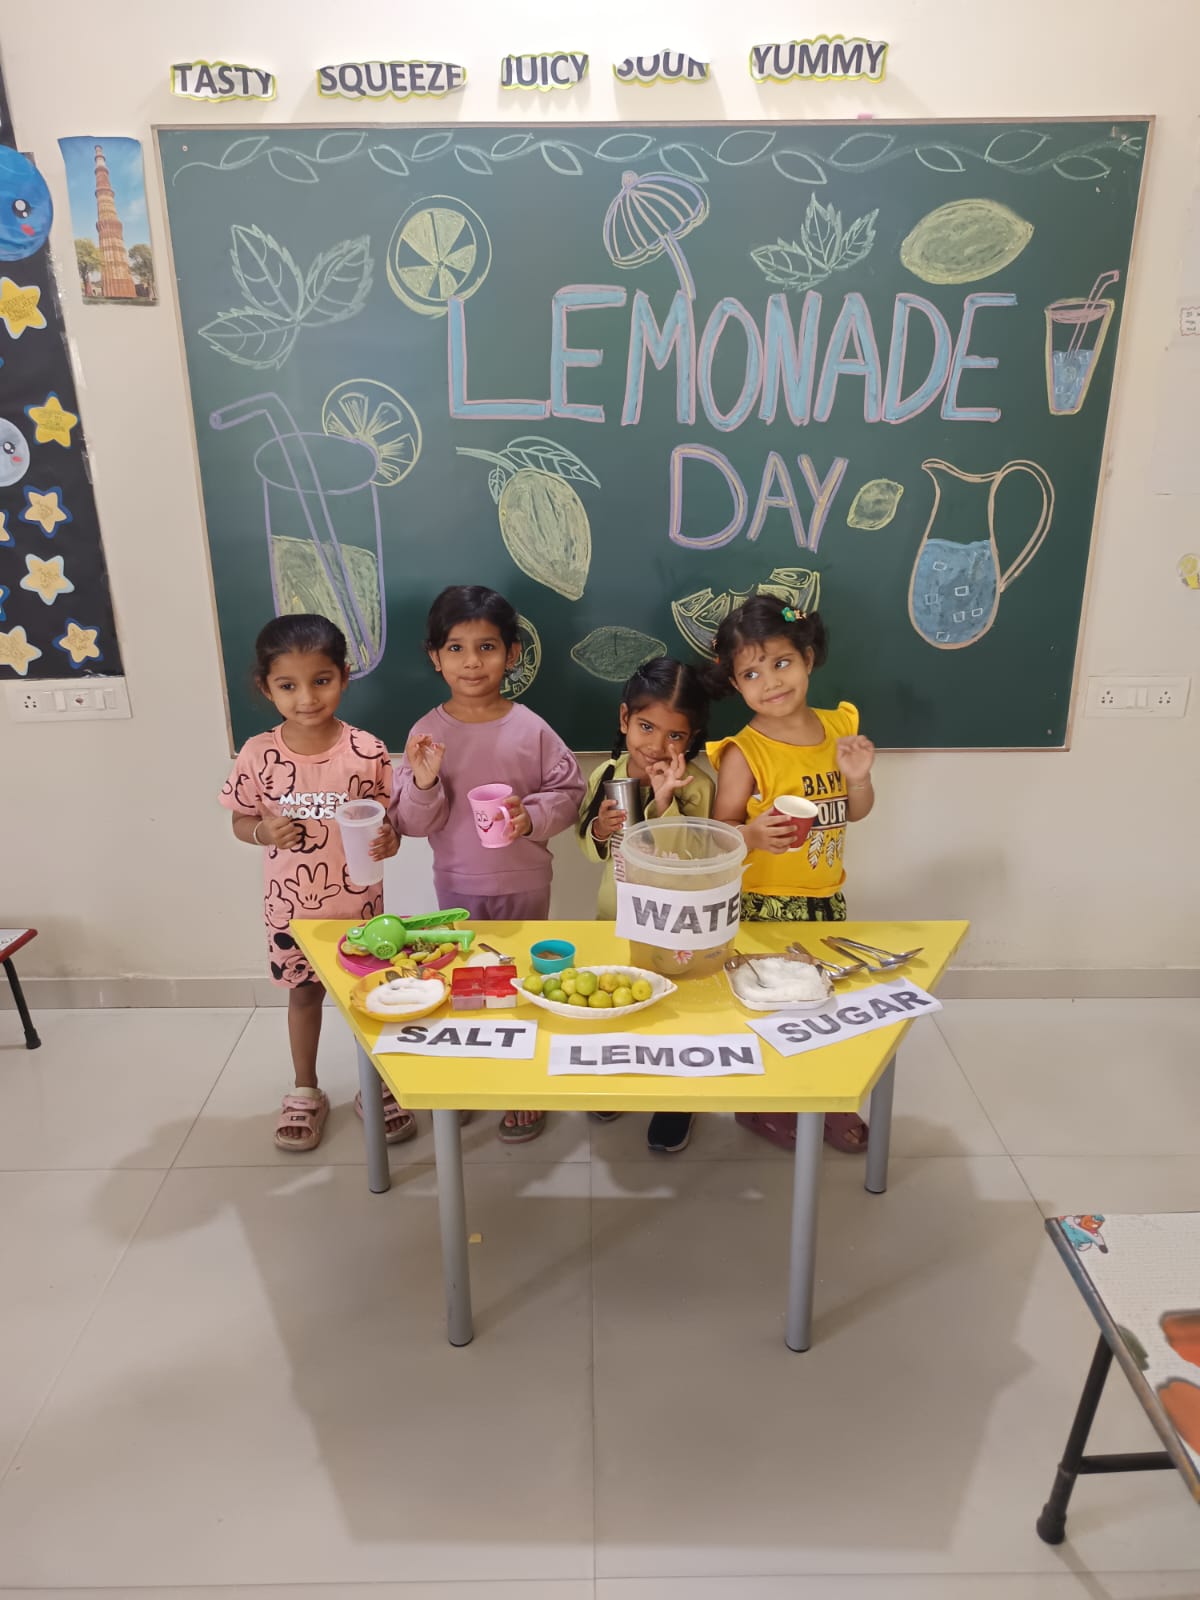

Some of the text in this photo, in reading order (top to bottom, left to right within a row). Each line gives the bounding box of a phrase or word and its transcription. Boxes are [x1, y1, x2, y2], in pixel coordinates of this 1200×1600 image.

[501, 54, 588, 86] JUICY
[753, 43, 886, 75] YUMMY
[173, 64, 271, 94] TASTY
[319, 63, 462, 96] SQUEEZE
[447, 284, 1018, 432] LEMONADE
[669, 443, 849, 554] DAY
[279, 791, 348, 805] MICKEY
[281, 806, 336, 820] MOUS
[817, 801, 846, 826] OUR
[631, 892, 739, 935] WATE
[776, 990, 932, 1044] SUGAR
[397, 1025, 526, 1048] SALT
[568, 1045, 754, 1068] LEMON
